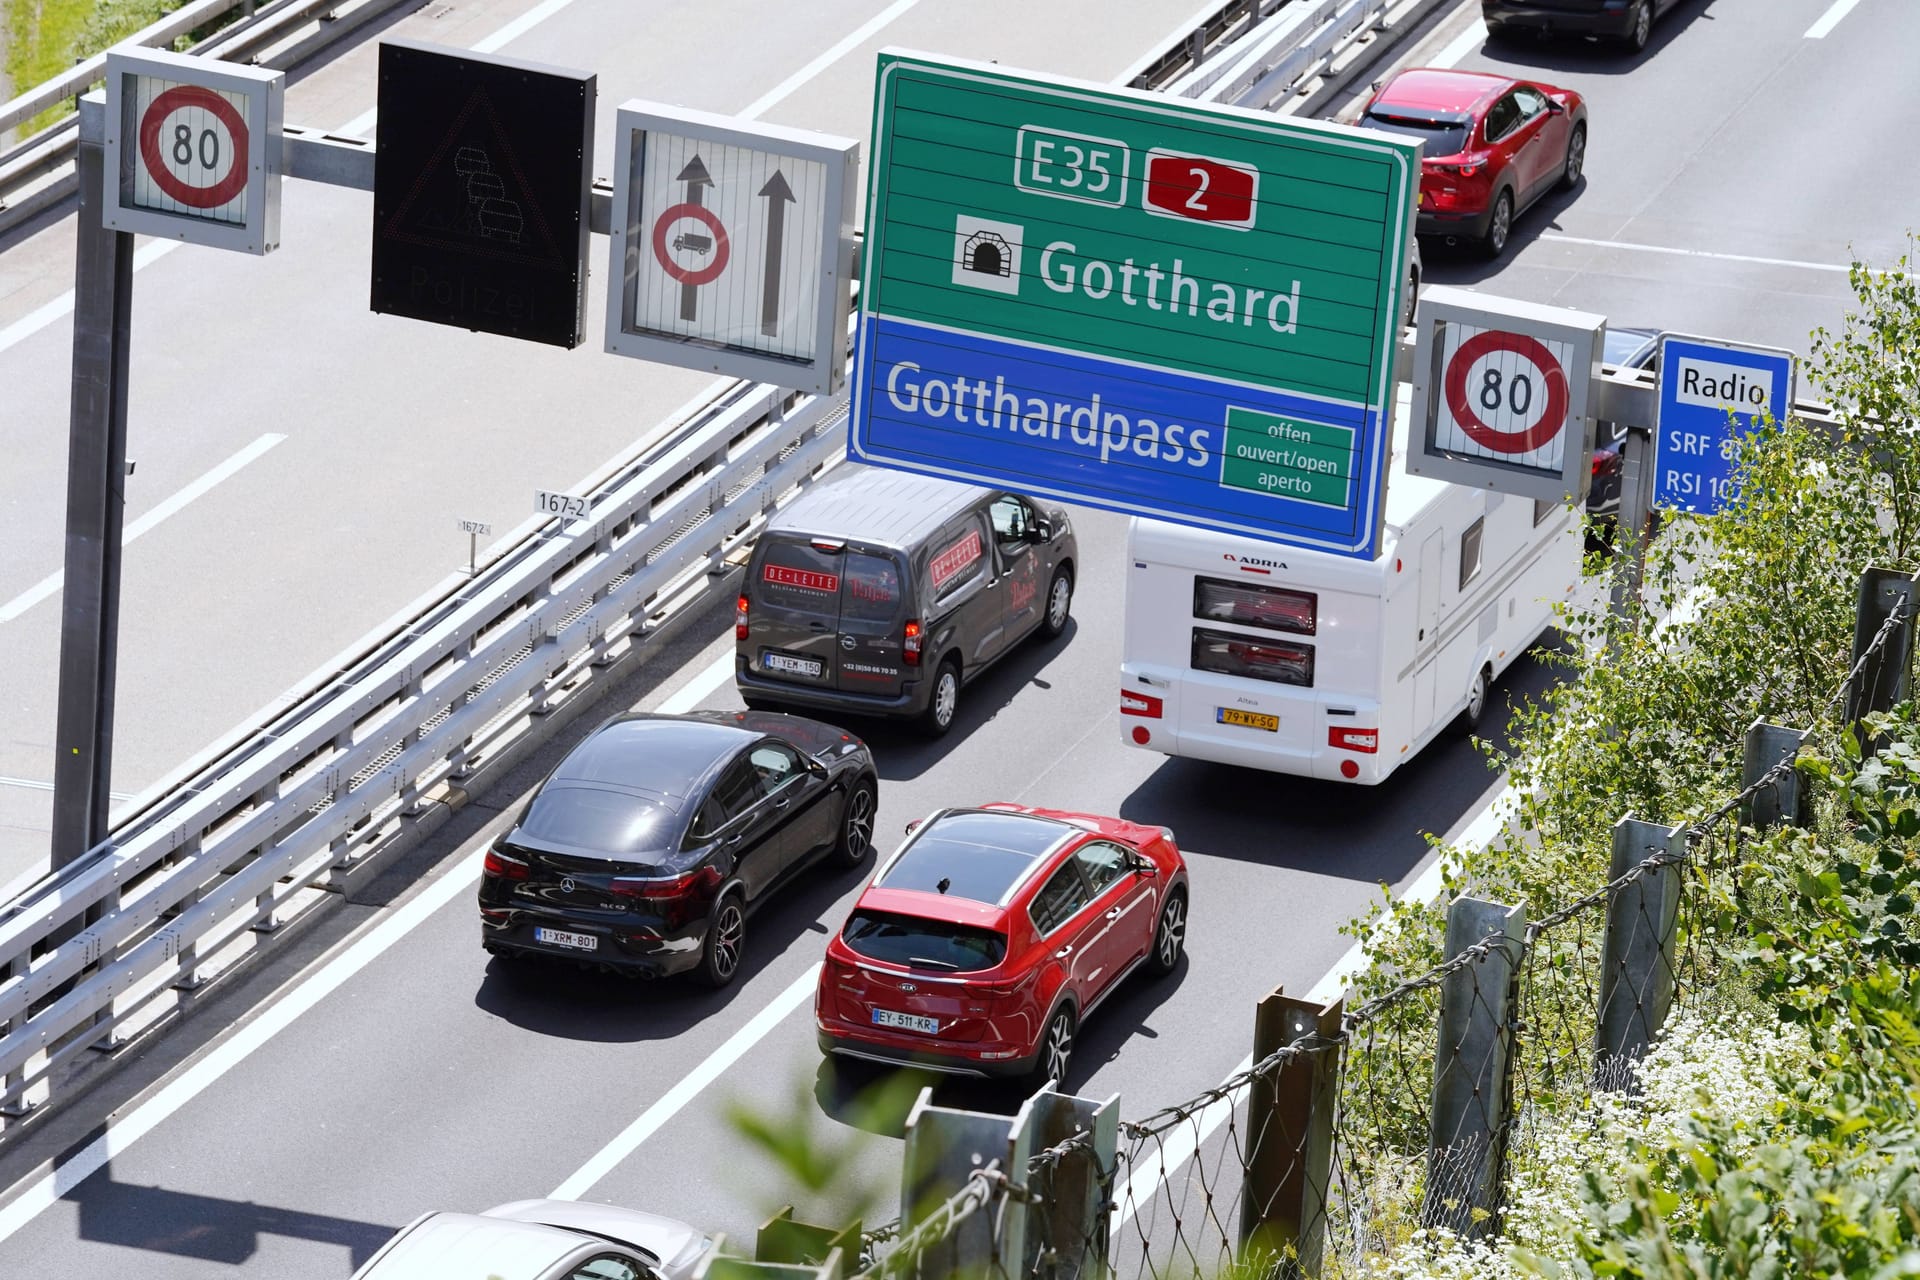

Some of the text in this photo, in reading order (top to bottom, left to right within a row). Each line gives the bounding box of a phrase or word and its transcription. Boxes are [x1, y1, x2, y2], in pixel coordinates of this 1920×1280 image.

[173, 124, 219, 170] 80
[1031, 139, 1210, 211] E35 2
[1040, 241, 1301, 335] Gotthard
[1480, 368, 1532, 415] 80
[1683, 368, 1765, 405] Radio
[887, 361, 1210, 467] Gotthardpass
[1267, 422, 1311, 444] offen
[1669, 431, 1711, 456] SRF
[1236, 444, 1338, 475] ouvert/open
[1258, 472, 1312, 493] aperto
[1666, 470, 1701, 495] RSI
[1240, 556, 1288, 570] ADRIA
